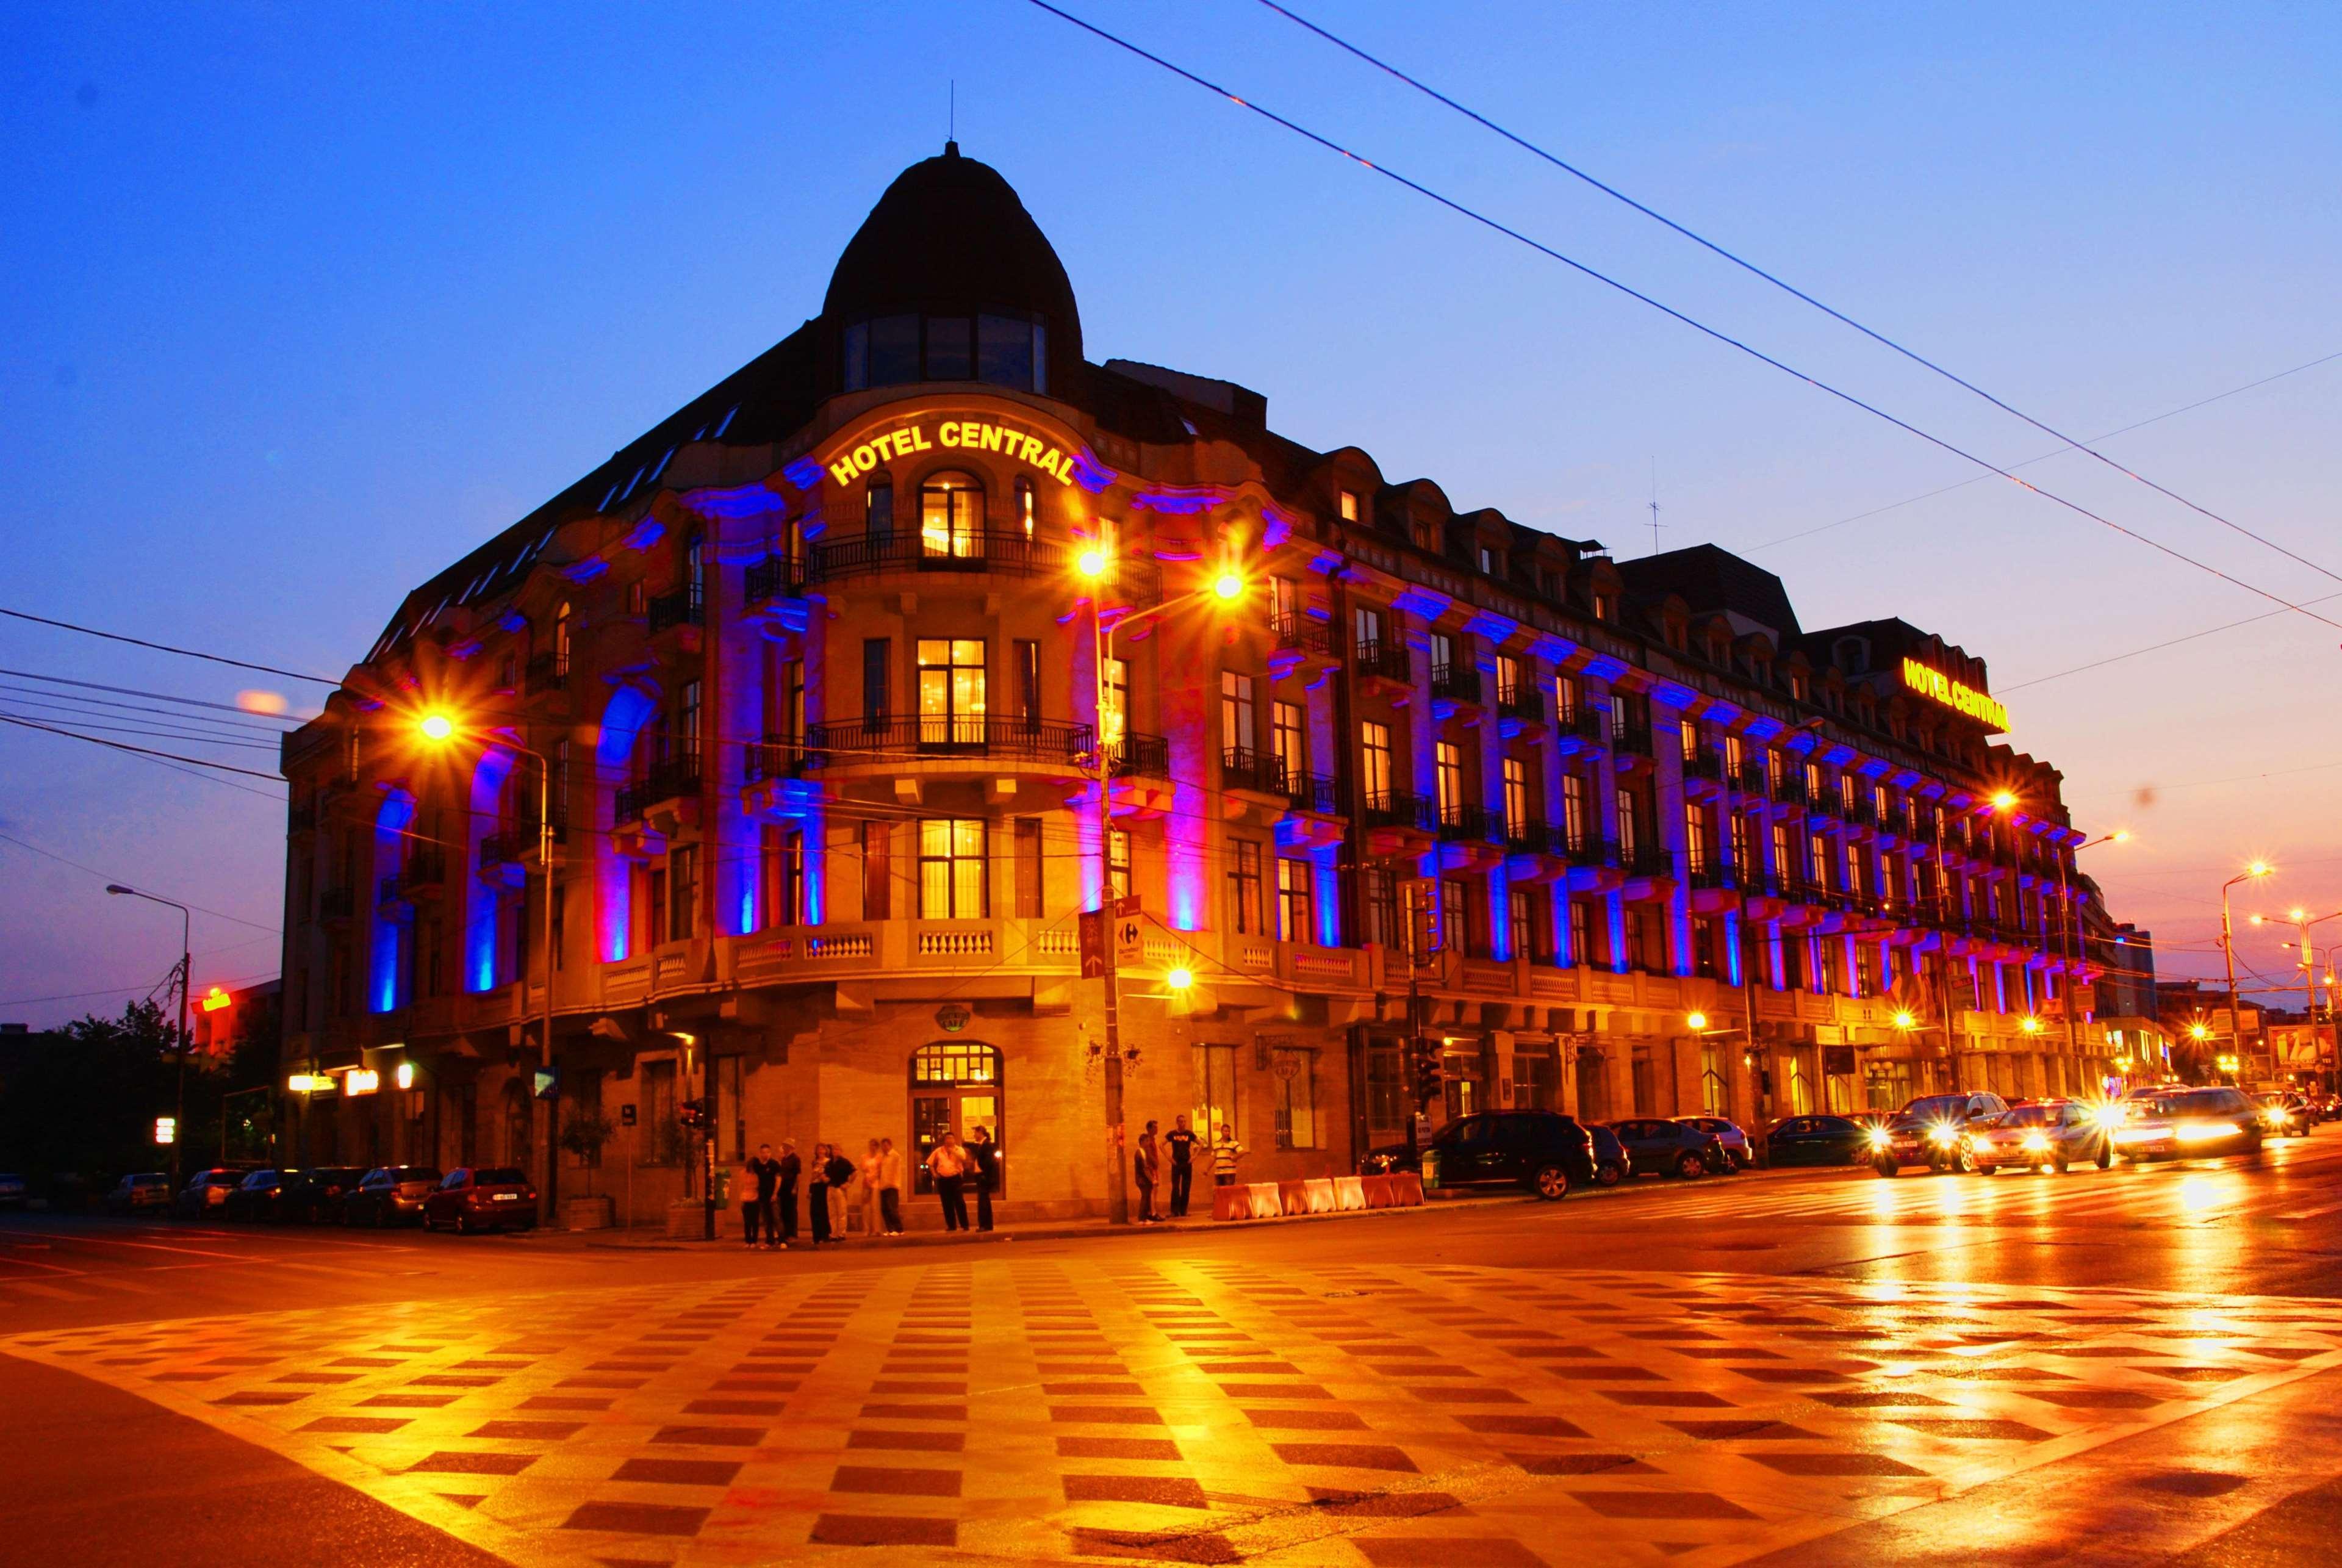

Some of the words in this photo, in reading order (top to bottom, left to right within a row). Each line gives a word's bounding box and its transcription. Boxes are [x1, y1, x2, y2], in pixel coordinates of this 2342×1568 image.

[829, 426, 932, 487] HOTEL
[939, 421, 1076, 487] CENTRAL
[1903, 656, 1953, 707] HOTEL
[1952, 680, 2012, 735] CENTRAL
